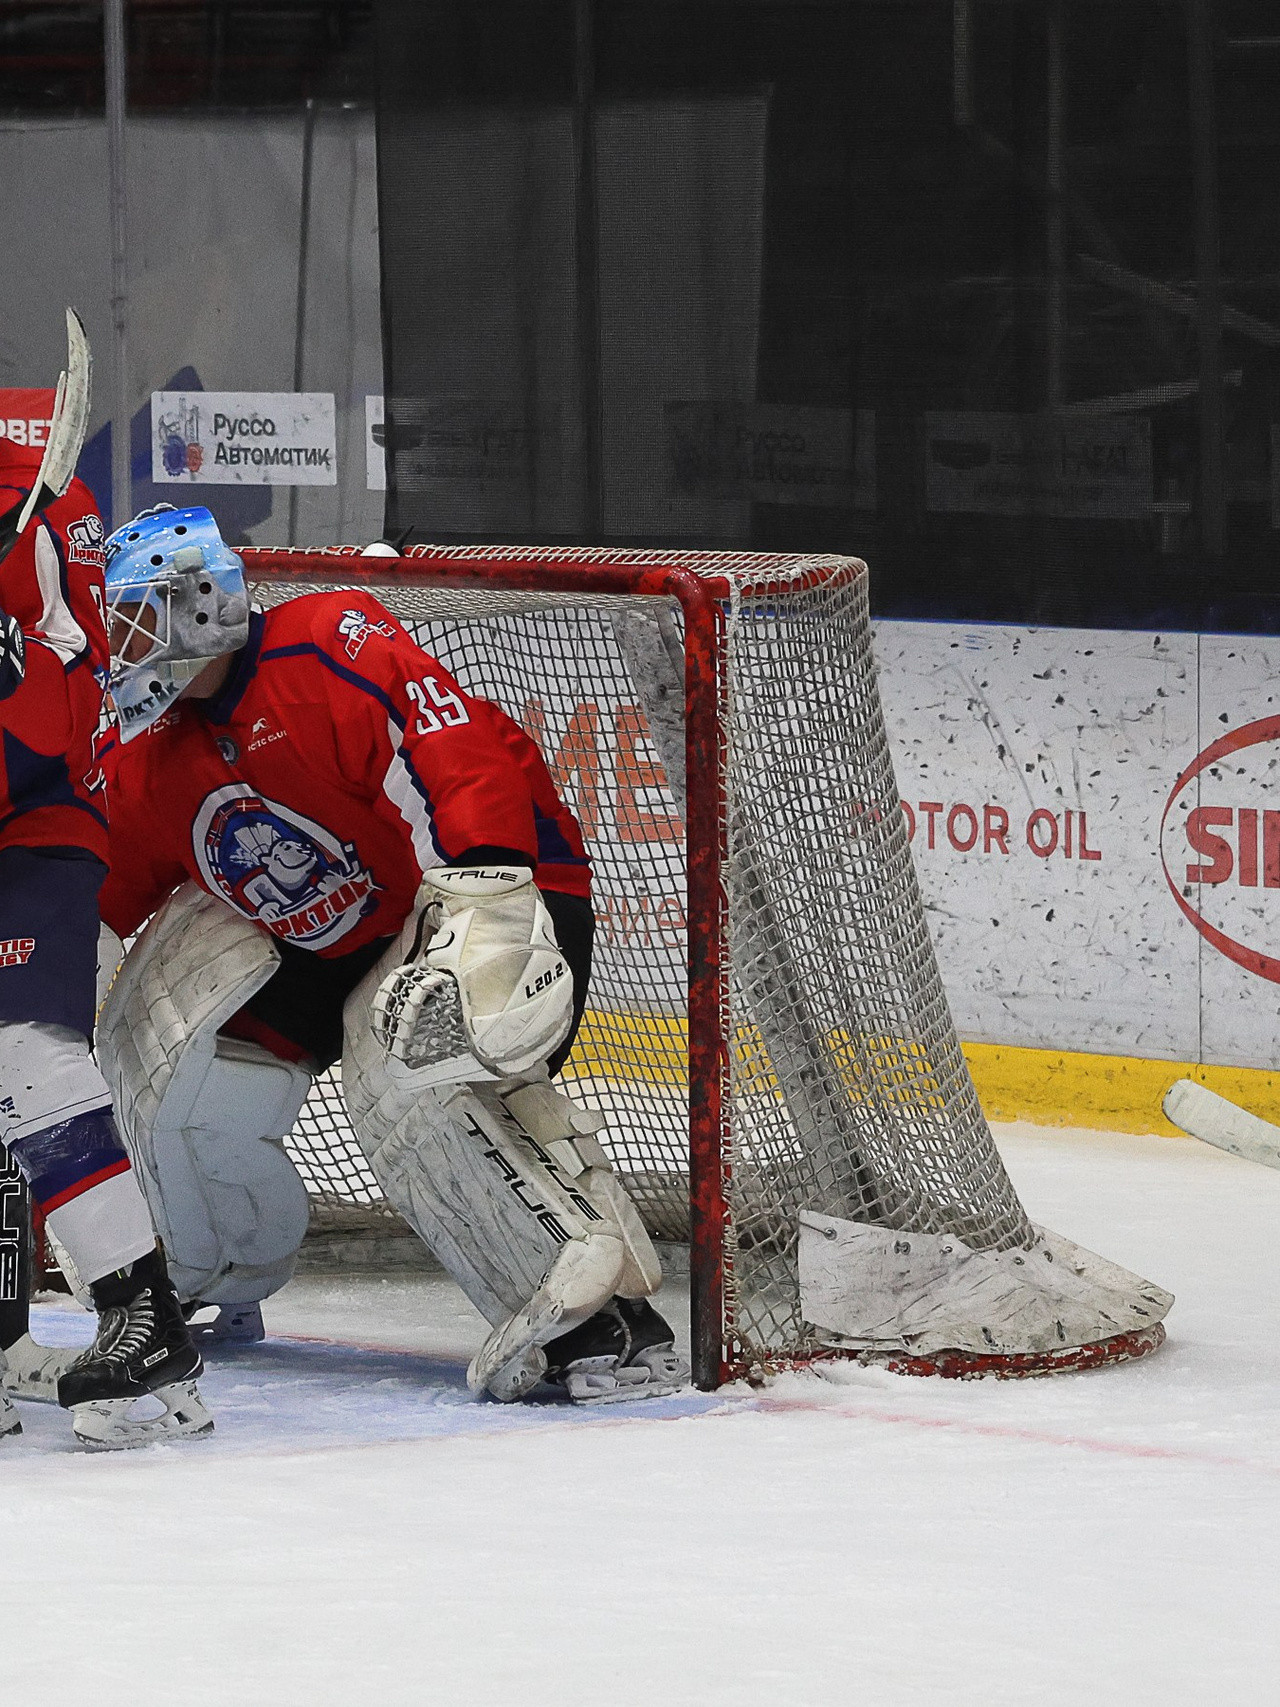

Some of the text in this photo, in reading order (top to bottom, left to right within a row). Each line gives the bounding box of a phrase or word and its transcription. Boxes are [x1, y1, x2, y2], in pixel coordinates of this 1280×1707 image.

[213, 413, 276, 440] Руссо
[214, 443, 332, 466] Автоматик
[1026, 808, 1102, 860] OIL
[440, 869, 519, 883] TRUE
[525, 961, 565, 999] L20.2
[463, 1111, 574, 1245] TRUE
[496, 1099, 605, 1222] TRUE
